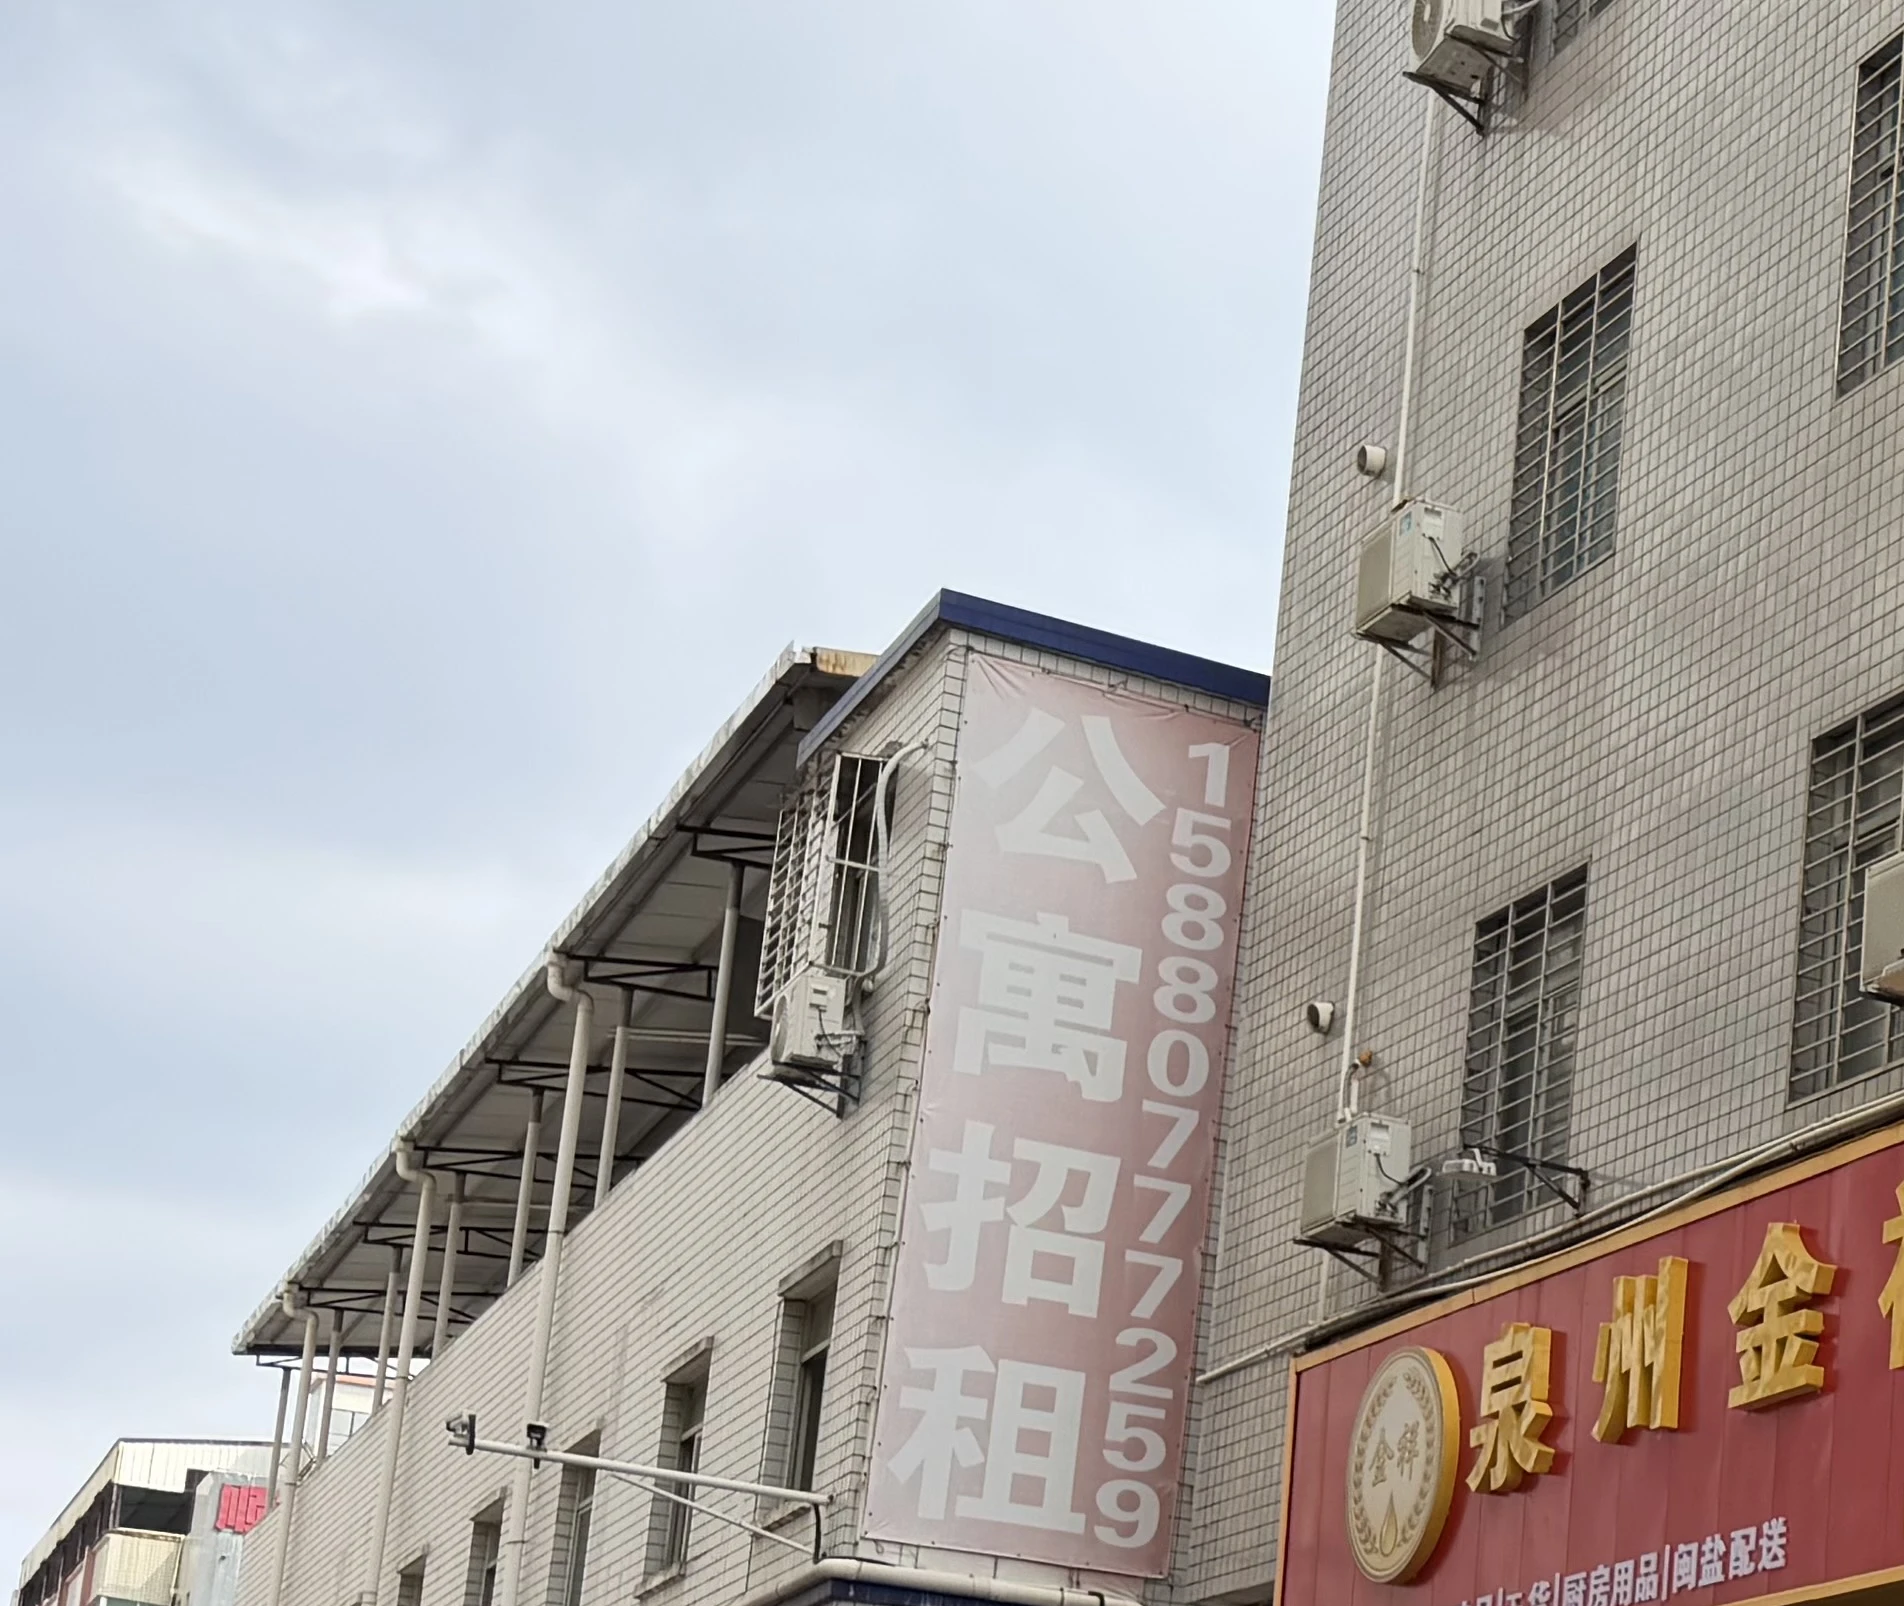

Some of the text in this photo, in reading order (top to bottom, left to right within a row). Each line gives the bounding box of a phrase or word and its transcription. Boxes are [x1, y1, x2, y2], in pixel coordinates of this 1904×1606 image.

[887, 711, 1167, 1538] 公寓招租
[1093, 740, 1233, 1549] 15880777259
